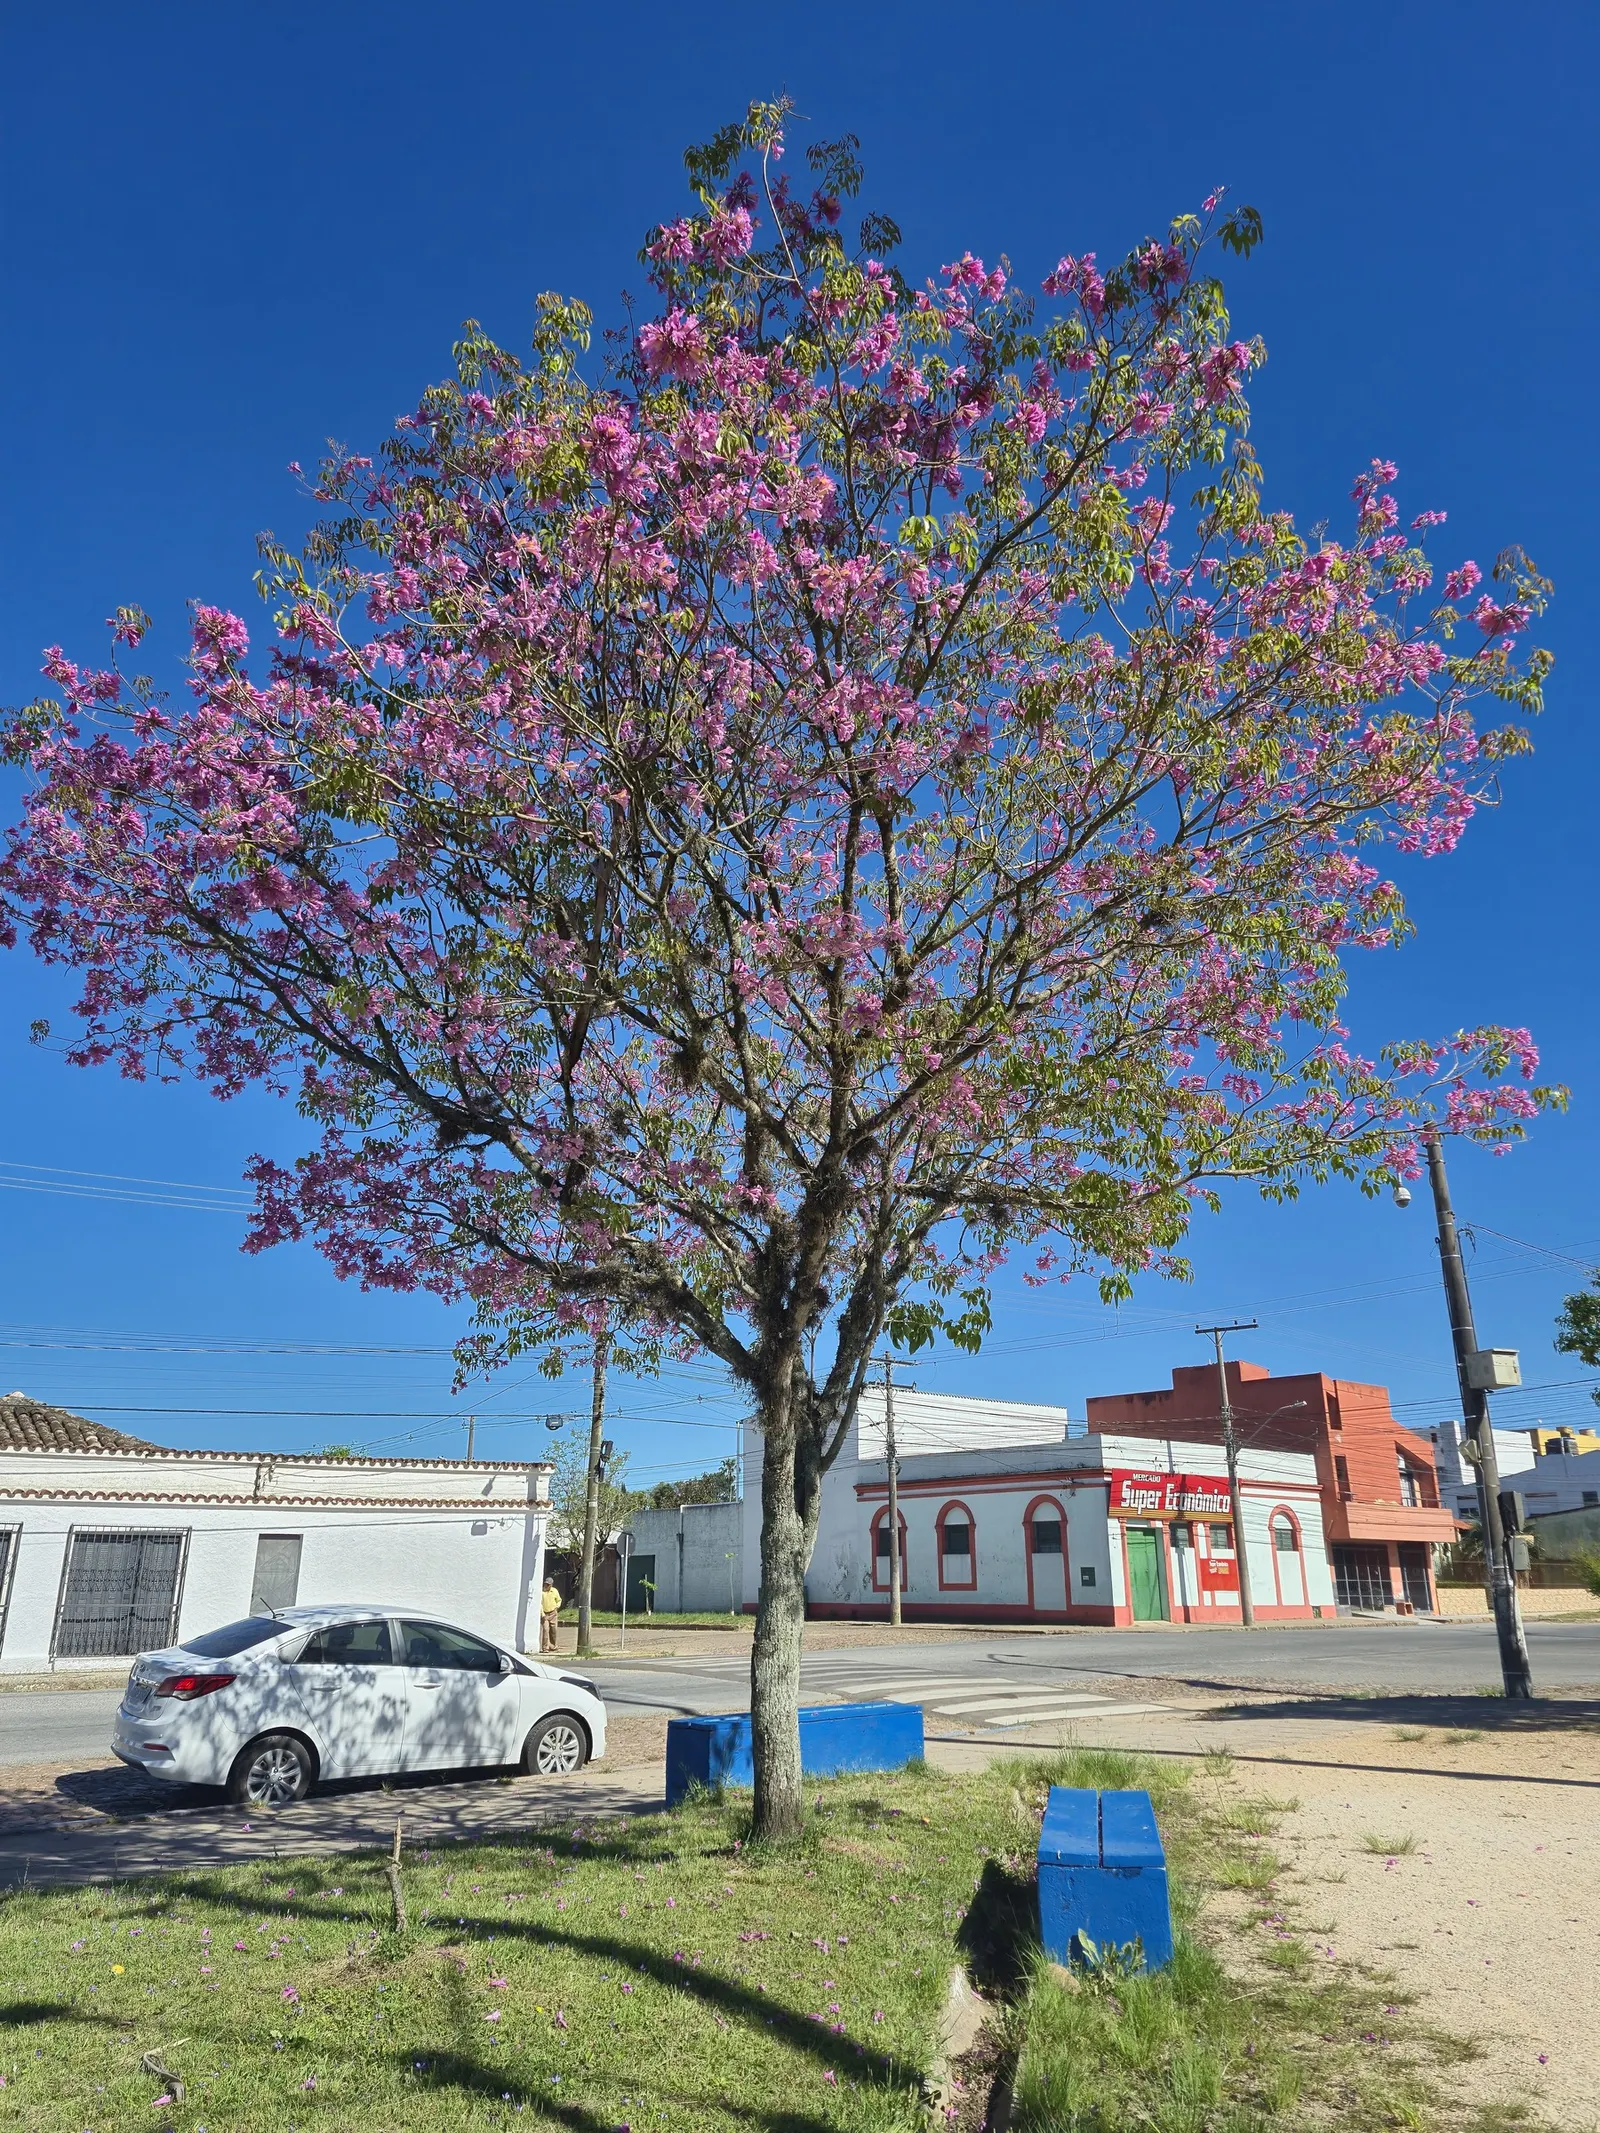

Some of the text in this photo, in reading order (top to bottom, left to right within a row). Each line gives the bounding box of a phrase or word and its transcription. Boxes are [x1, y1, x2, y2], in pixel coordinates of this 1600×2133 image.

[1132, 1473, 1161, 1483] MERCADO
[1120, 1480, 1231, 1515] Super Econômico
